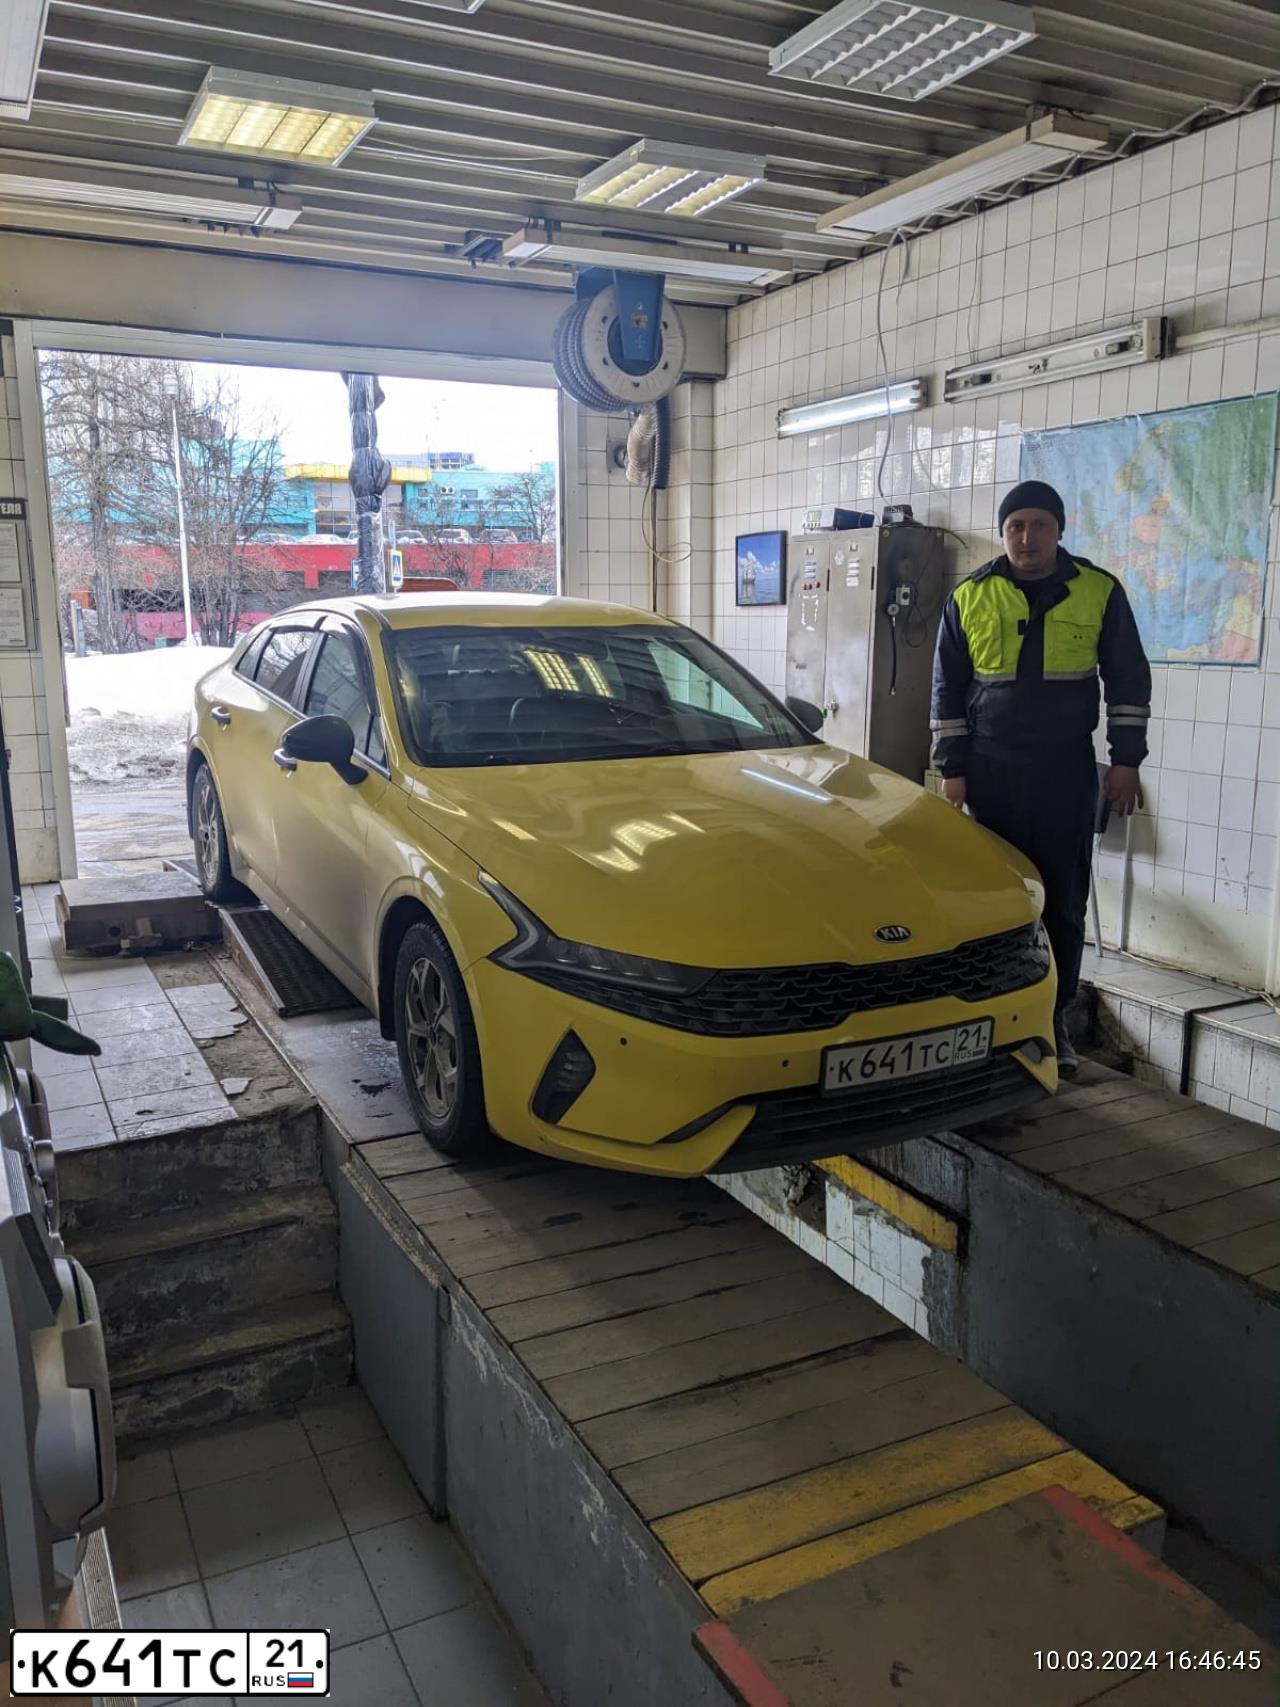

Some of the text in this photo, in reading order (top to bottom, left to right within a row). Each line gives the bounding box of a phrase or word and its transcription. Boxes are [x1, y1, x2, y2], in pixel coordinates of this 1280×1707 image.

[879, 926, 910, 940] KIA
[956, 1025, 982, 1052] 21
[954, 1049, 973, 1061] RUS
